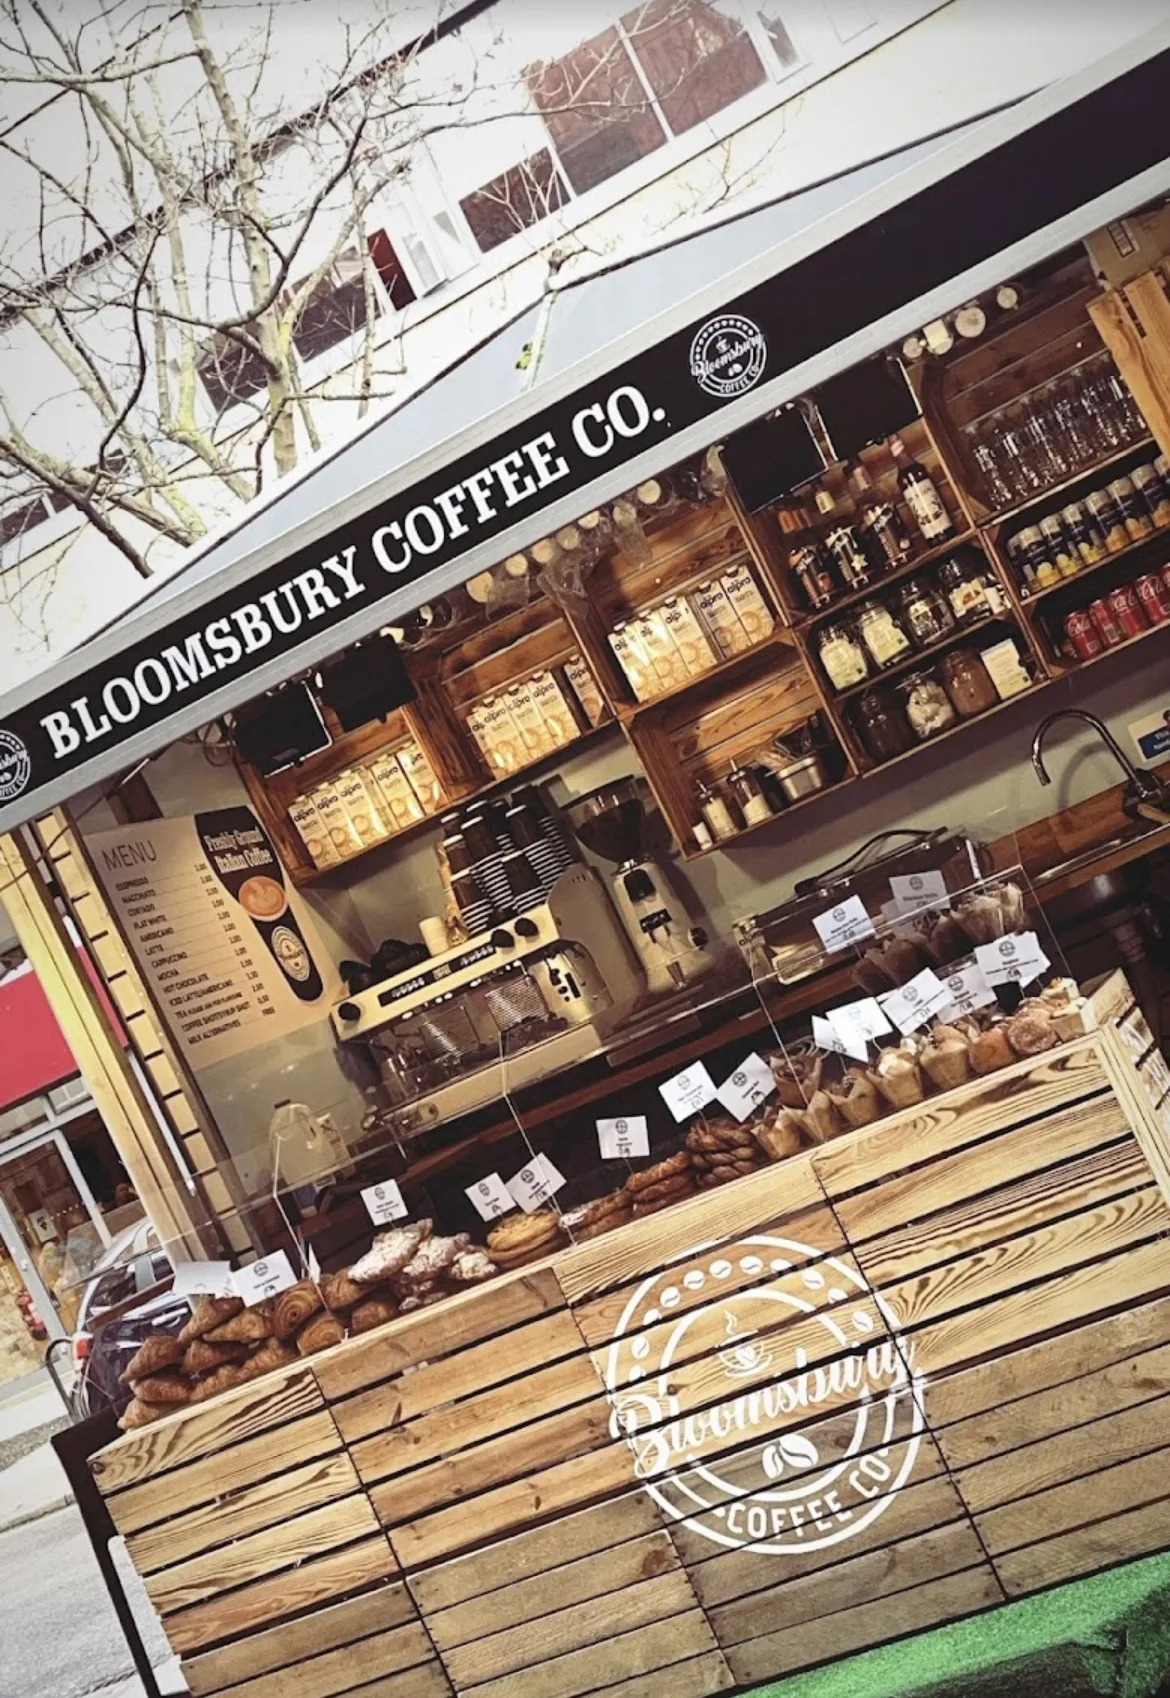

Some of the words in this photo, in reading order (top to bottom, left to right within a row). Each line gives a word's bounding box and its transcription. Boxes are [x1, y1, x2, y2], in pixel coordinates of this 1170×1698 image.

[39, 546, 365, 759] BLOOMSBURY
[371, 432, 570, 574] COFFEE
[570, 384, 666, 458] CO.
[102, 840, 157, 871] MENU
[609, 1340, 928, 1480] Bloomsbury
[727, 1489, 854, 1540] COFFEE
